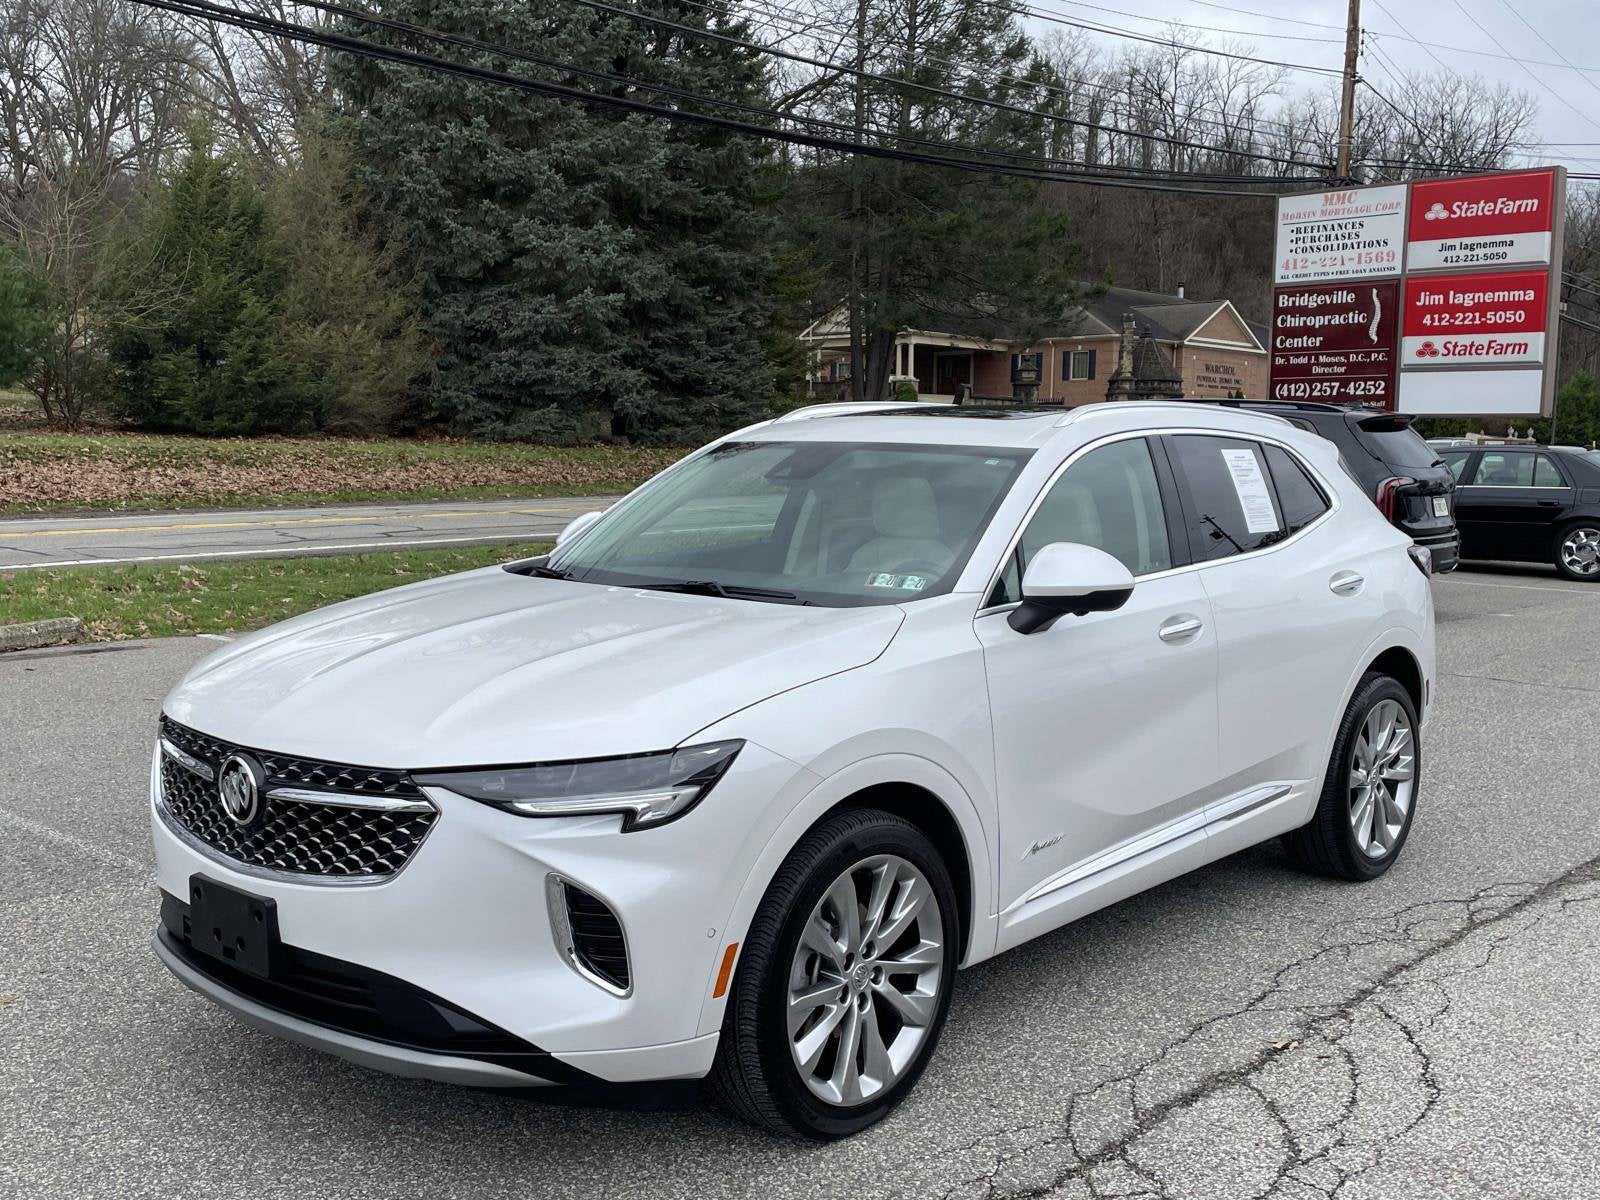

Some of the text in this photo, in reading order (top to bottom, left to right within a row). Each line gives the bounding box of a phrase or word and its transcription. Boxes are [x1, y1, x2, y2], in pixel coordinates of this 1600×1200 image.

[1322, 191, 1359, 207] MMC
[1320, 204, 1372, 217] MORTGAGE
[1295, 220, 1365, 235] REFINANCES
[1294, 231, 1361, 245] PURCHASES
[1438, 239, 1514, 252] Jim Iagnemma
[1294, 238, 1389, 254] CONSOLIDATIONS
[1282, 250, 1396, 270] 412-221-1569
[1443, 252, 1508, 263] 412-221-5050
[1278, 290, 1356, 308] Bridgeville
[1416, 289, 1535, 307] Jim Iagnemma
[1277, 310, 1368, 329] Chiropractic
[1422, 310, 1526, 326] 412-221-5050
[1276, 335, 1324, 349] Center
[1275, 357, 1288, 365] Dr.
[1289, 355, 1308, 364] Todd
[1310, 355, 1317, 364] J.
[1318, 355, 1348, 364] Moses,
[1371, 352, 1388, 361] P.C.
[1312, 365, 1347, 374] Director
[1275, 380, 1386, 399] (412) 257-4252
